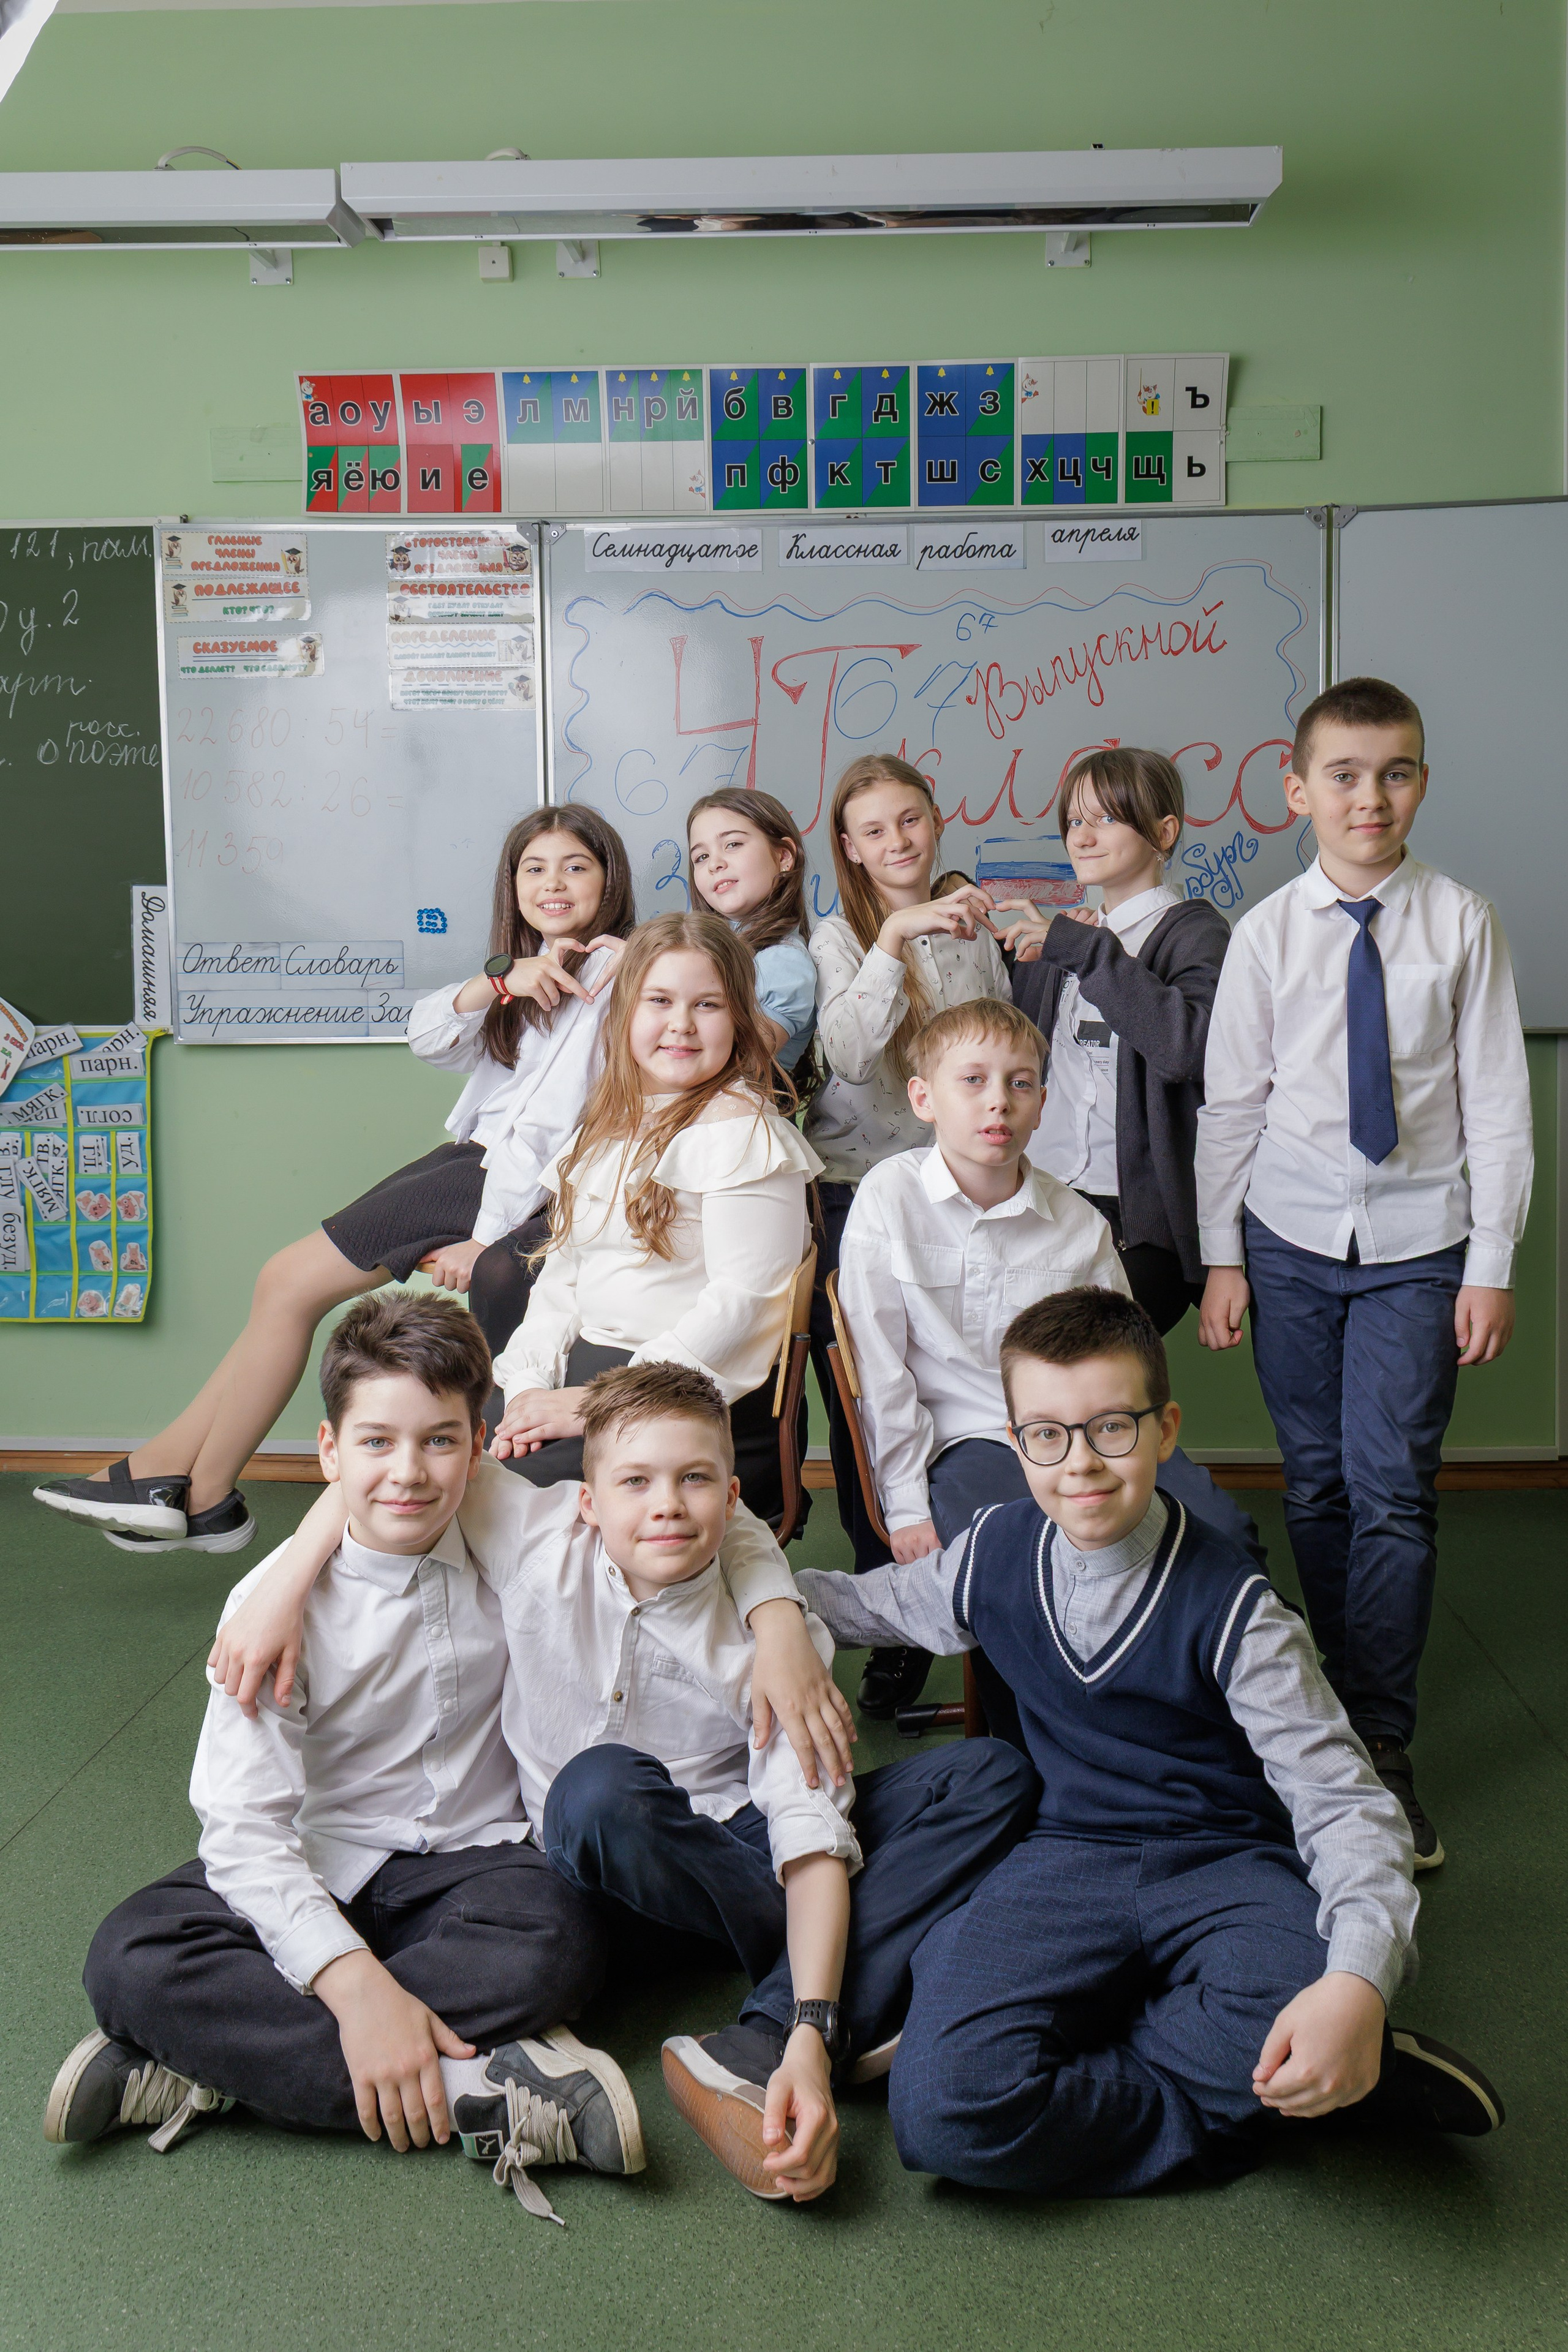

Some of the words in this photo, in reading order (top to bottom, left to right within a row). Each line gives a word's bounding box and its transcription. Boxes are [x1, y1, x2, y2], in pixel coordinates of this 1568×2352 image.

[208, 535, 262, 546] ГЛАВНЫЕ
[592, 532, 759, 568] Семнадцатое
[786, 533, 901, 559] Классная
[918, 530, 1016, 569] работа
[1052, 526, 1141, 555] апреля
[191, 560, 281, 572] ПРЕДЛОЖЕНИЯ
[215, 548, 255, 559] ЧЛЕНЫ
[437, 550, 478, 560] ЧЛЕНЫ
[414, 562, 503, 573] ПРЕДЛОЖЕНИЯ
[194, 581, 301, 597] ПОДЛЕЖАЩЕЕ
[400, 583, 530, 595] ОБСТОЯТЕЛЬСТВО
[63, 589, 80, 627] 2
[223, 606, 247, 615] КТО?
[391, 628, 497, 644] ОПРЕДЕЛЕНИЕ
[956, 612, 999, 641] 67
[193, 640, 279, 654] СКАЗУЕМОЕ
[404, 670, 503, 683] ДОПОЛНЕНИЕ
[966, 600, 1229, 740] Выпускной
[833, 657, 979, 747] 67
[141, 891, 165, 1022] Домашняя
[183, 943, 280, 974] Ответ
[285, 945, 399, 987] Словарь
[183, 994, 364, 1036] Упражнение
[102, 1028, 140, 1053] арн.
[79, 1055, 138, 1076] парн.
[11, 1088, 64, 1122] мягк.
[80, 1109, 132, 1123] согл.
[82, 1144, 96, 1173] гл.
[119, 1137, 139, 1168] уд.
[23, 1161, 59, 1215] мягк.
[0, 1212, 21, 1270] безуд.
